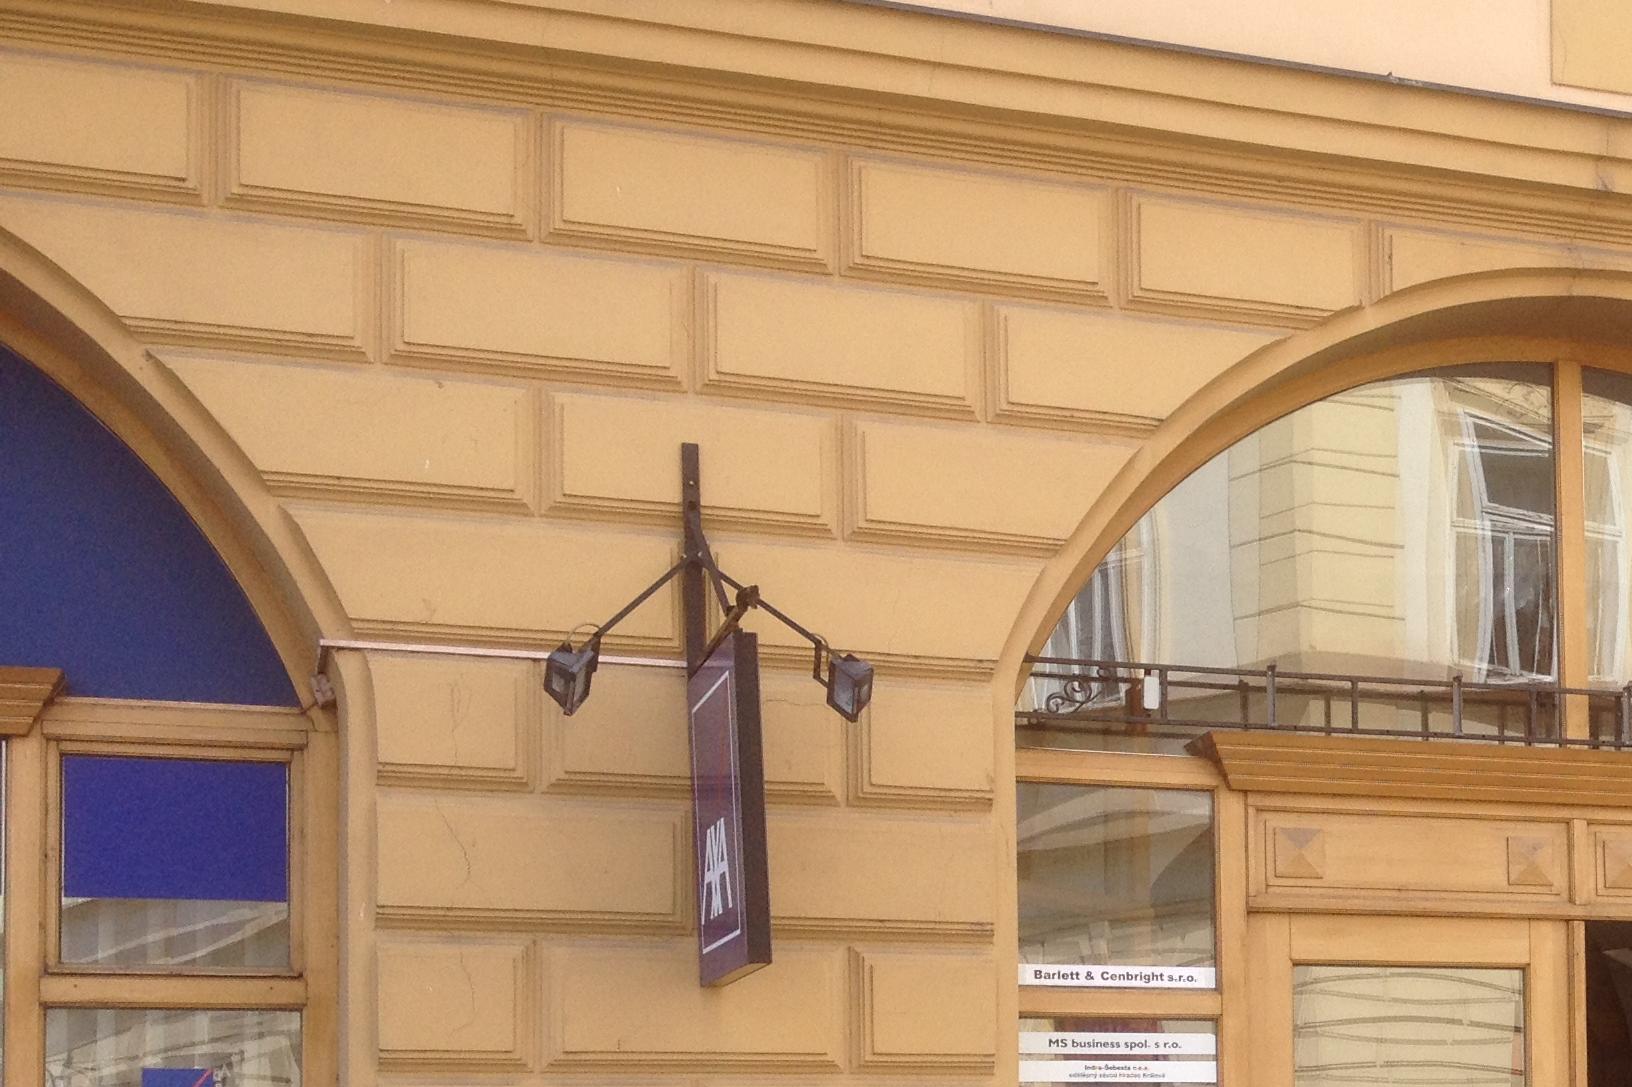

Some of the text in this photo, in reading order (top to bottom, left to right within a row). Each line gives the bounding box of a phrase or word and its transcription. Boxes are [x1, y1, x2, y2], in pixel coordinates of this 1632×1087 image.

[701, 817, 733, 925] AXA
[1034, 969, 1197, 983] Barlett & Cenbright s.r.o.
[1048, 1038, 1068, 1048] MS
[1072, 1038, 1120, 1049] business
[1124, 1038, 1151, 1051] spol.
[1163, 1041, 1182, 1049] r.o.
